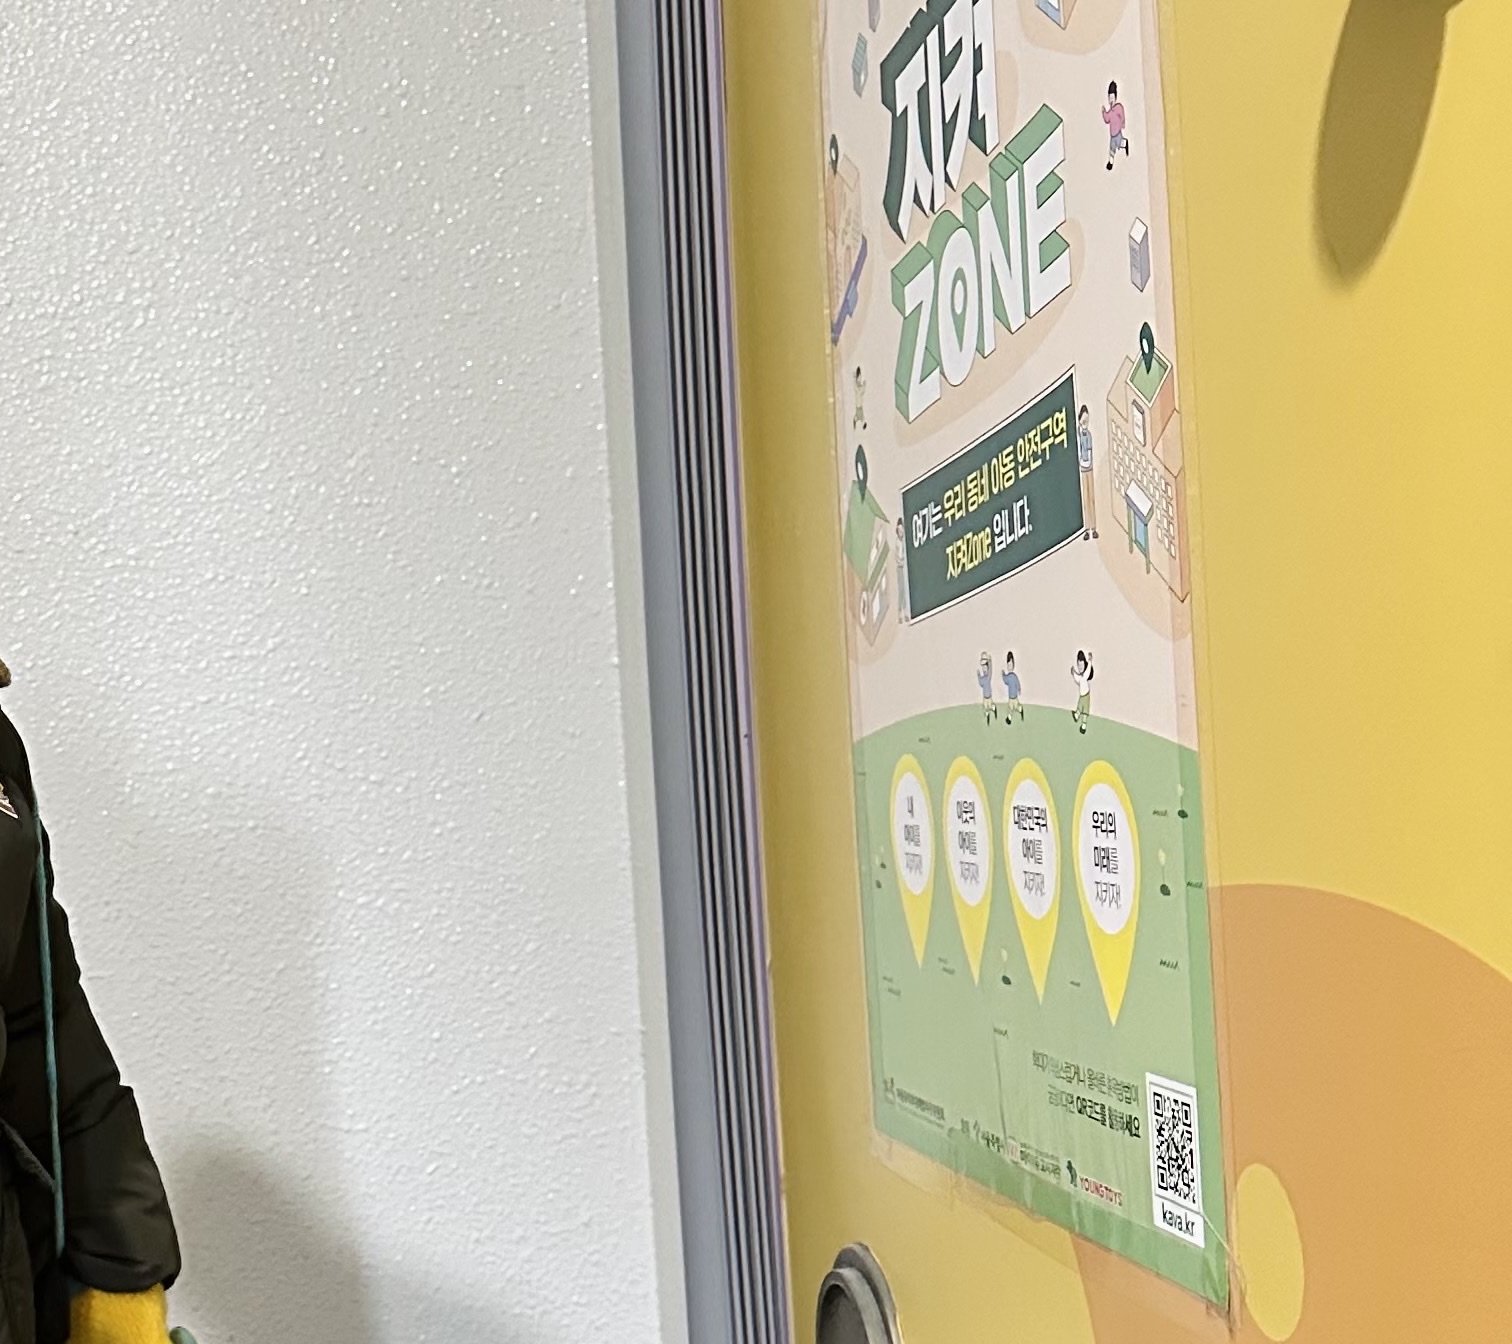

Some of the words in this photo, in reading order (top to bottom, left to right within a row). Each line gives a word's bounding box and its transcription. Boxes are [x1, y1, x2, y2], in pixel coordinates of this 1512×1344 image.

[891, 104, 1072, 424] ZONE
[911, 501, 943, 548] 여기는
[943, 480, 966, 527] 우리
[966, 462, 989, 513] 동네
[990, 445, 1015, 494] 아동
[1017, 406, 1068, 479] 안전구역
[945, 527, 992, 581] 지켜Zone
[993, 495, 1033, 553] 입니다.
[1012, 804, 1049, 833] 대한민국의
[1091, 810, 1117, 840] 우리의
[1021, 837, 1044, 865] 아이를
[1093, 846, 1120, 874] 미래를
[1161, 1202, 1196, 1237] kava.kr
